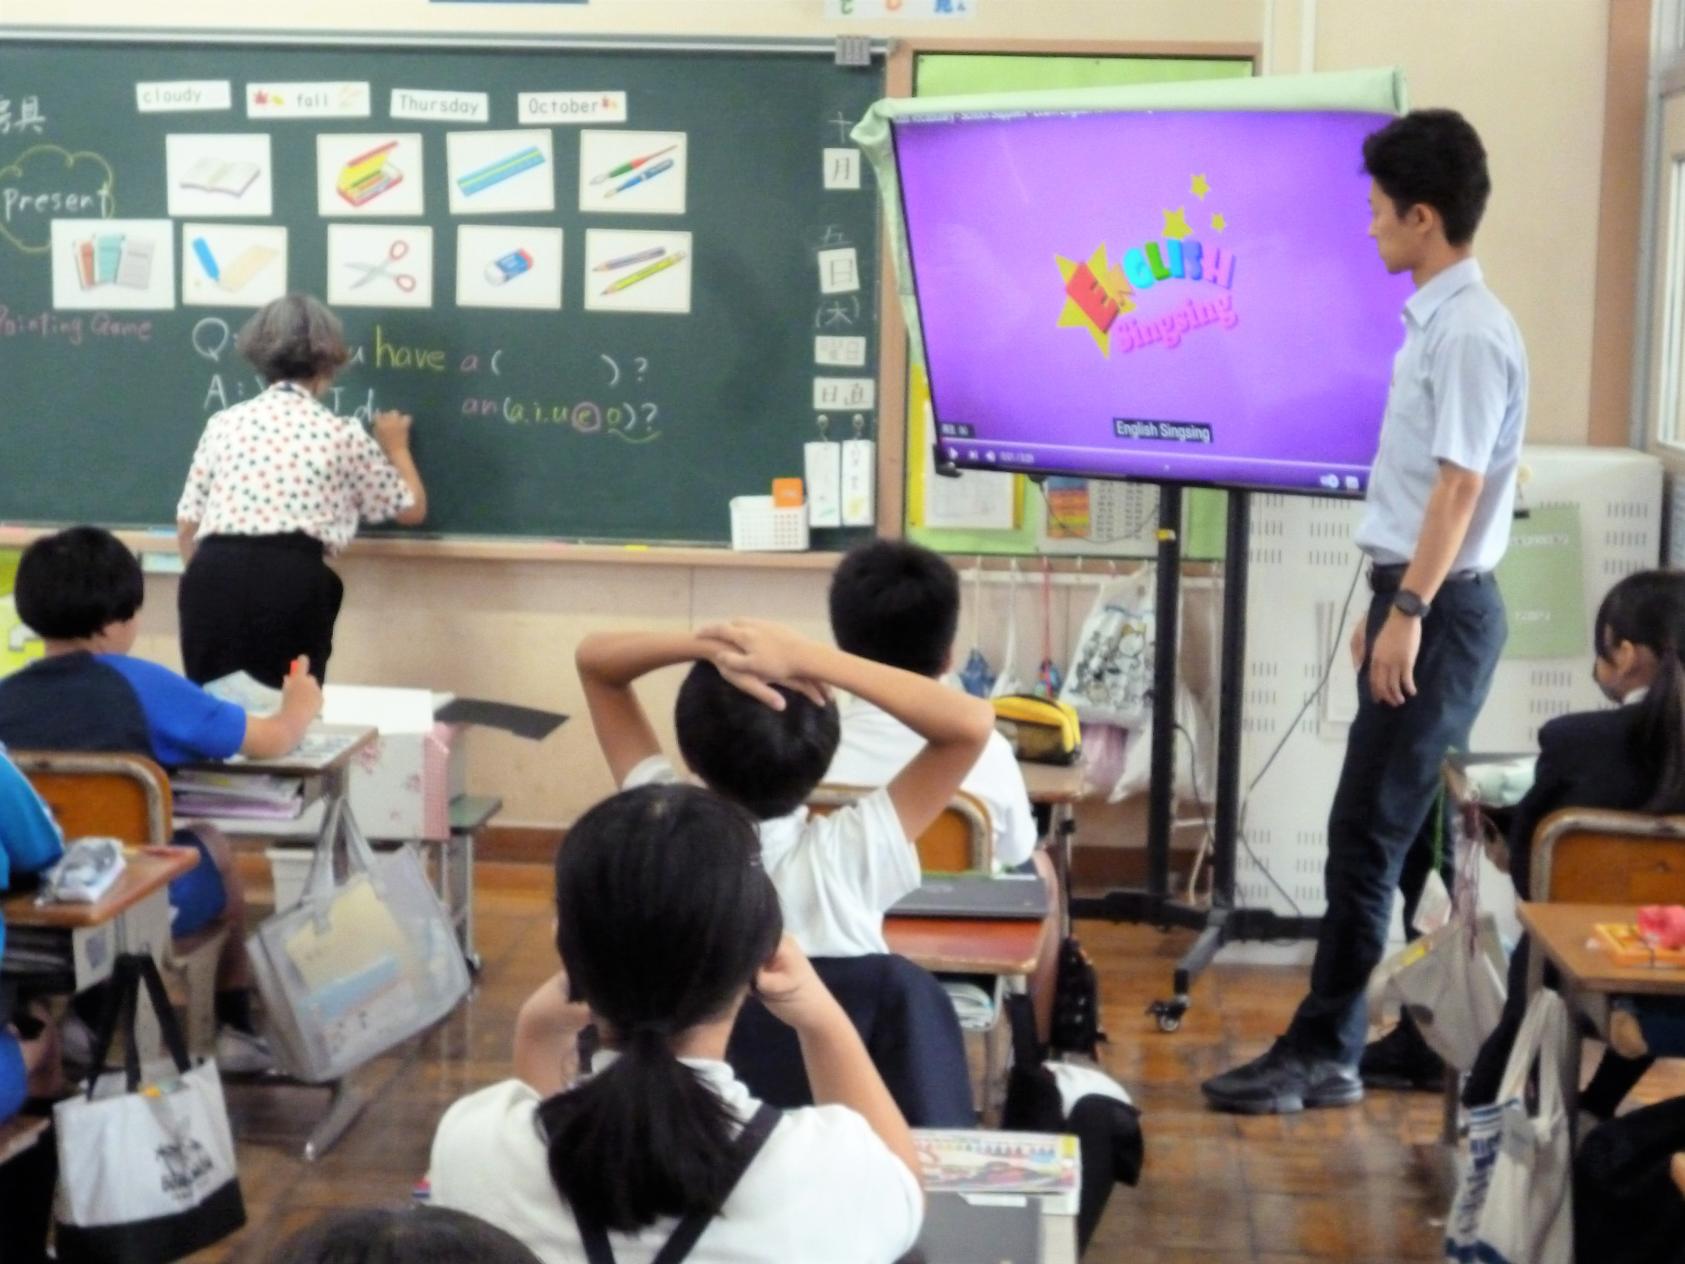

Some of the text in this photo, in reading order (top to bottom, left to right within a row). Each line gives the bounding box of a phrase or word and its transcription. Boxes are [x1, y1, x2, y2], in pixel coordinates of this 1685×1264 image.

[143, 87, 202, 104] cloudy
[297, 93, 329, 108] fall
[399, 95, 479, 115] Thursday
[528, 97, 598, 115] October
[1115, 293, 1239, 353] Singsing
[376, 324, 446, 371] have
[460, 354, 479, 373] a
[1116, 420, 1211, 444] English Singsing
